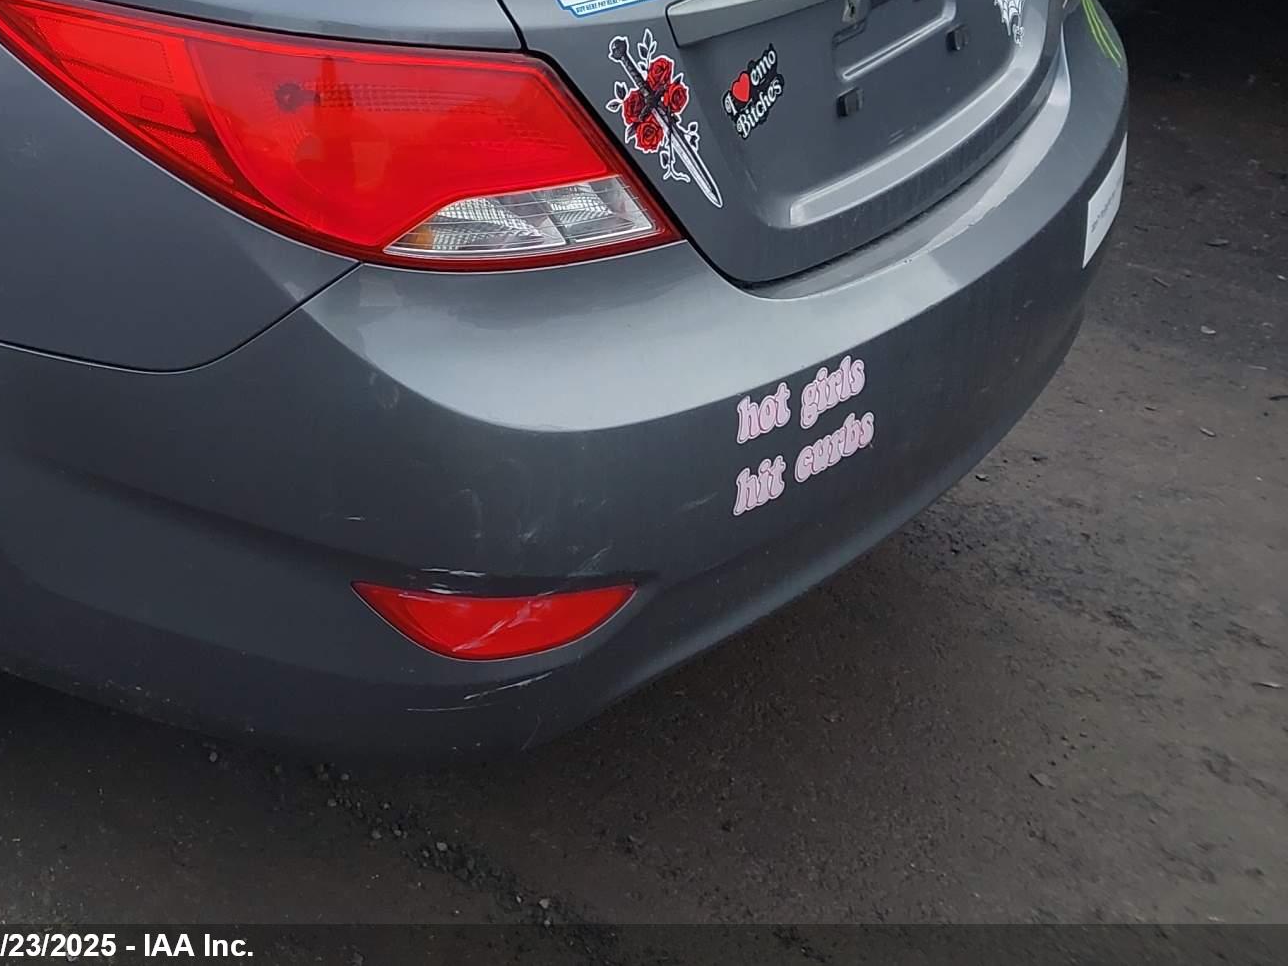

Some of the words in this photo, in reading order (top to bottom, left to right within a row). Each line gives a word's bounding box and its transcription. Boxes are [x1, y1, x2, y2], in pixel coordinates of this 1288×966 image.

[750, 50, 776, 86] emo
[737, 79, 782, 139] Bitches
[736, 382, 791, 444] hot
[800, 355, 866, 429] girls
[733, 455, 787, 516] hit
[794, 411, 875, 483] curbs
